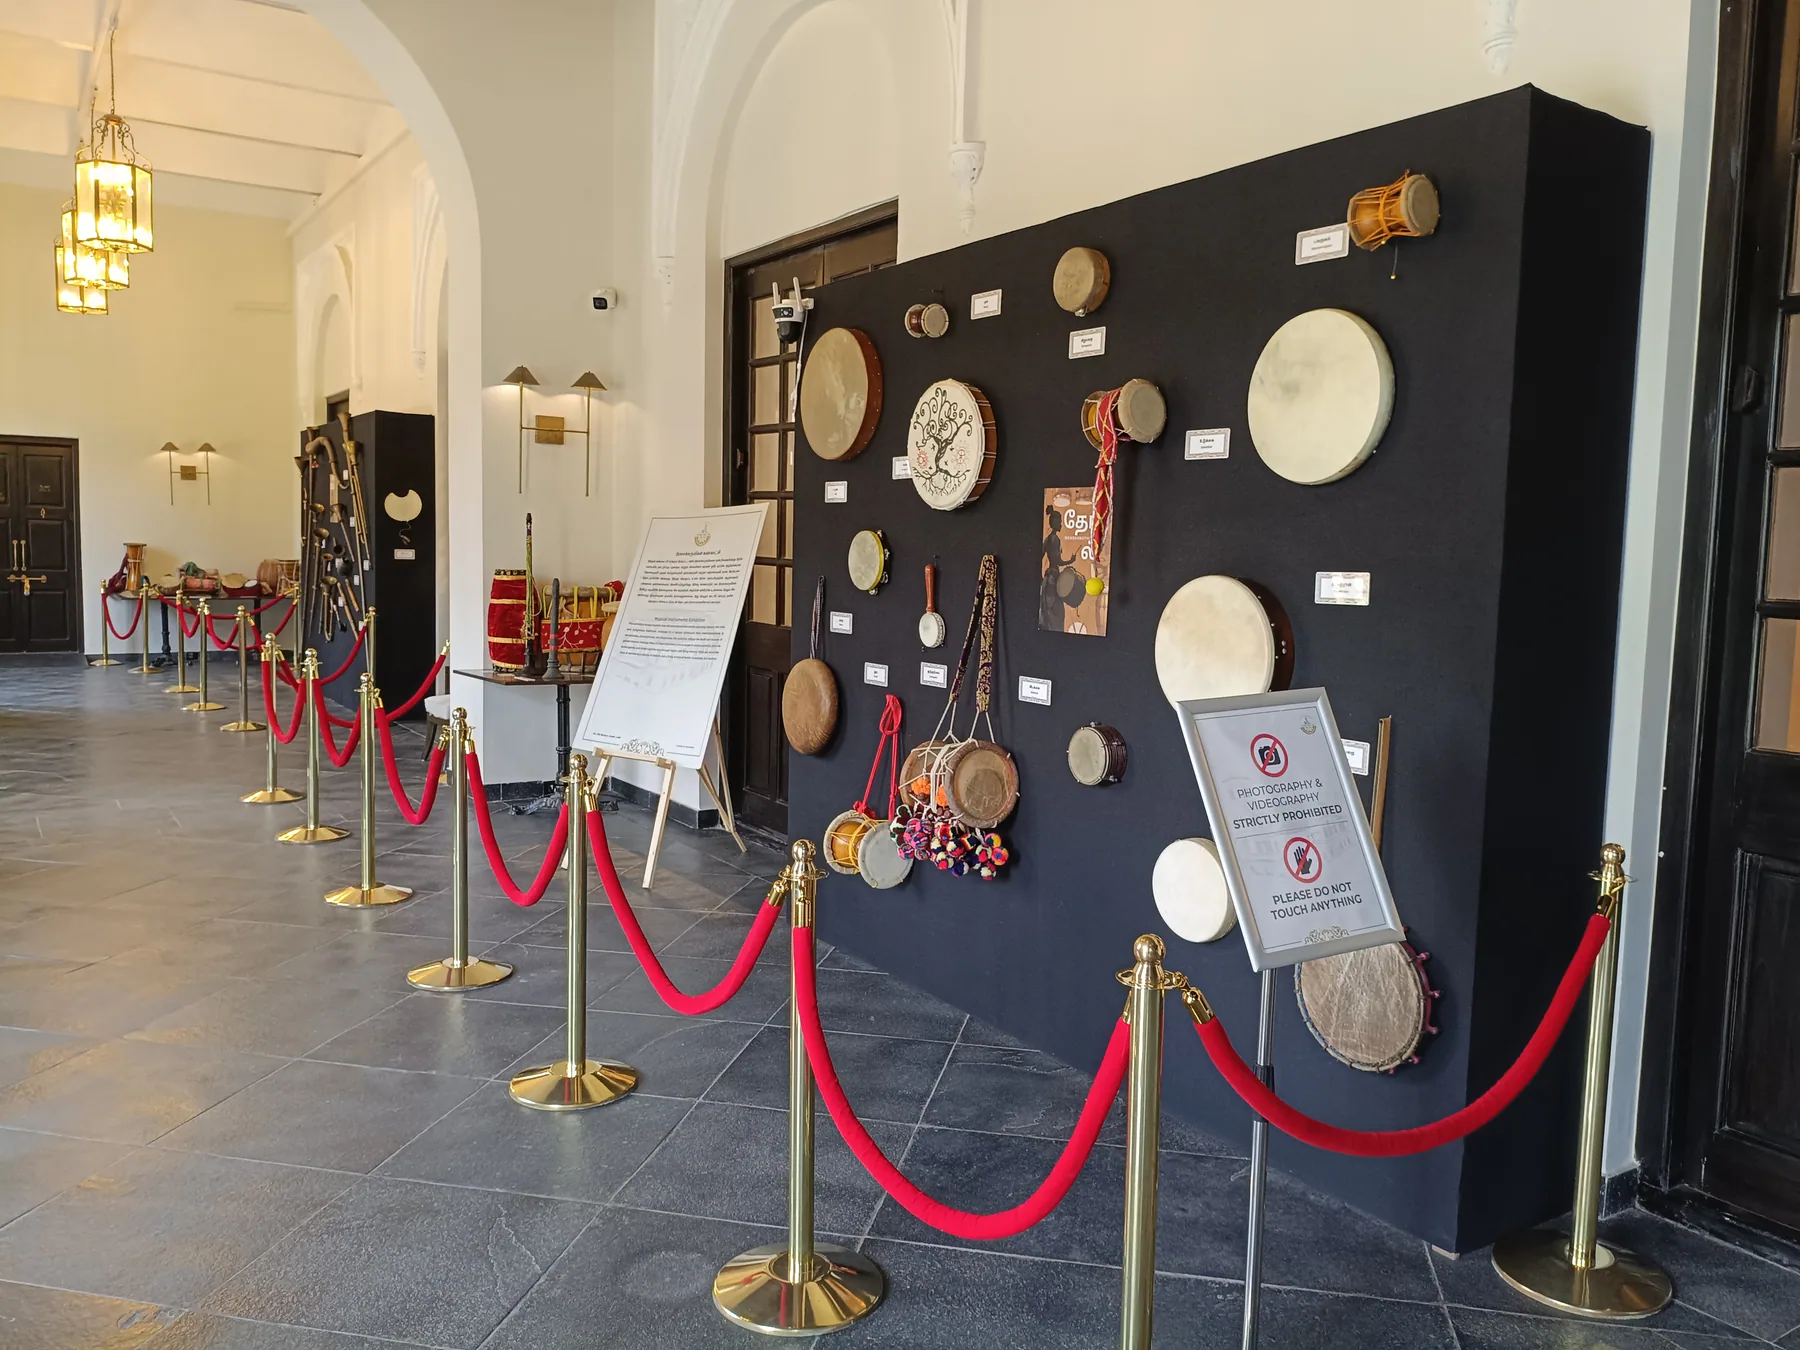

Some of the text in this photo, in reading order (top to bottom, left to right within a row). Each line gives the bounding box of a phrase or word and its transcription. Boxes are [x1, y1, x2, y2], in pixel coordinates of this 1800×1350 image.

[1237, 778, 1323, 798] PHOTOGRAPHY &
[1247, 792, 1319, 811] VIDEOGRAPHY
[1233, 804, 1342, 829] STRICTLY PROHIBITED
[1272, 882, 1352, 905] PLEASE DO NOT
[1270, 894, 1362, 920] TOUCH ANYTHING
